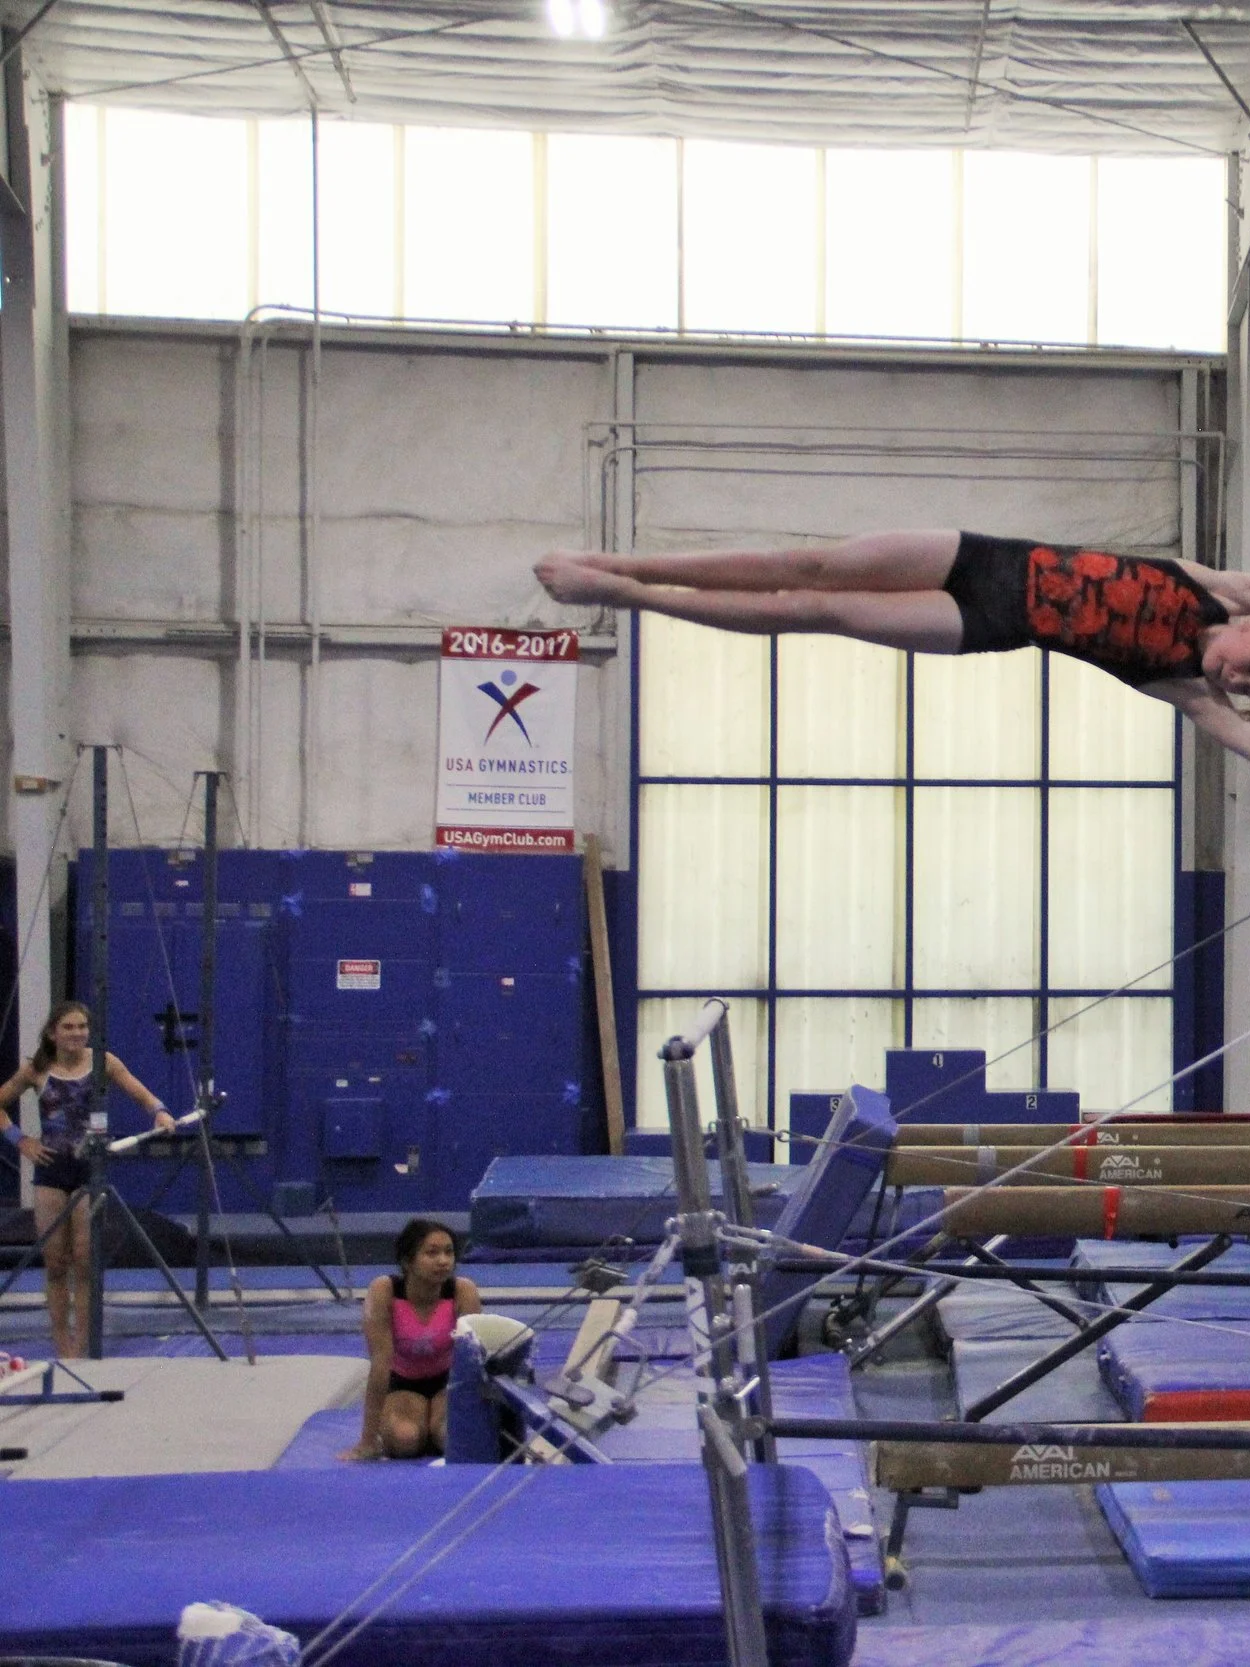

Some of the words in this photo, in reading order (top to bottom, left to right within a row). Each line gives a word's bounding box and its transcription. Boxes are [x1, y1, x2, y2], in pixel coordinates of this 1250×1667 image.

[450, 631, 570, 656] 2016-2017
[446, 758, 473, 772] USA
[479, 758, 568, 774] GYMNASTICS
[468, 792, 515, 804] MEMBER
[518, 793, 546, 806] CLUB
[444, 832, 566, 848] USAGymClub.com
[832, 1098, 839, 1111] 3
[1028, 1096, 1036, 1109] 2
[1099, 1169, 1162, 1180] AMERICAN
[1010, 1462, 1110, 1480] AMERICAN
